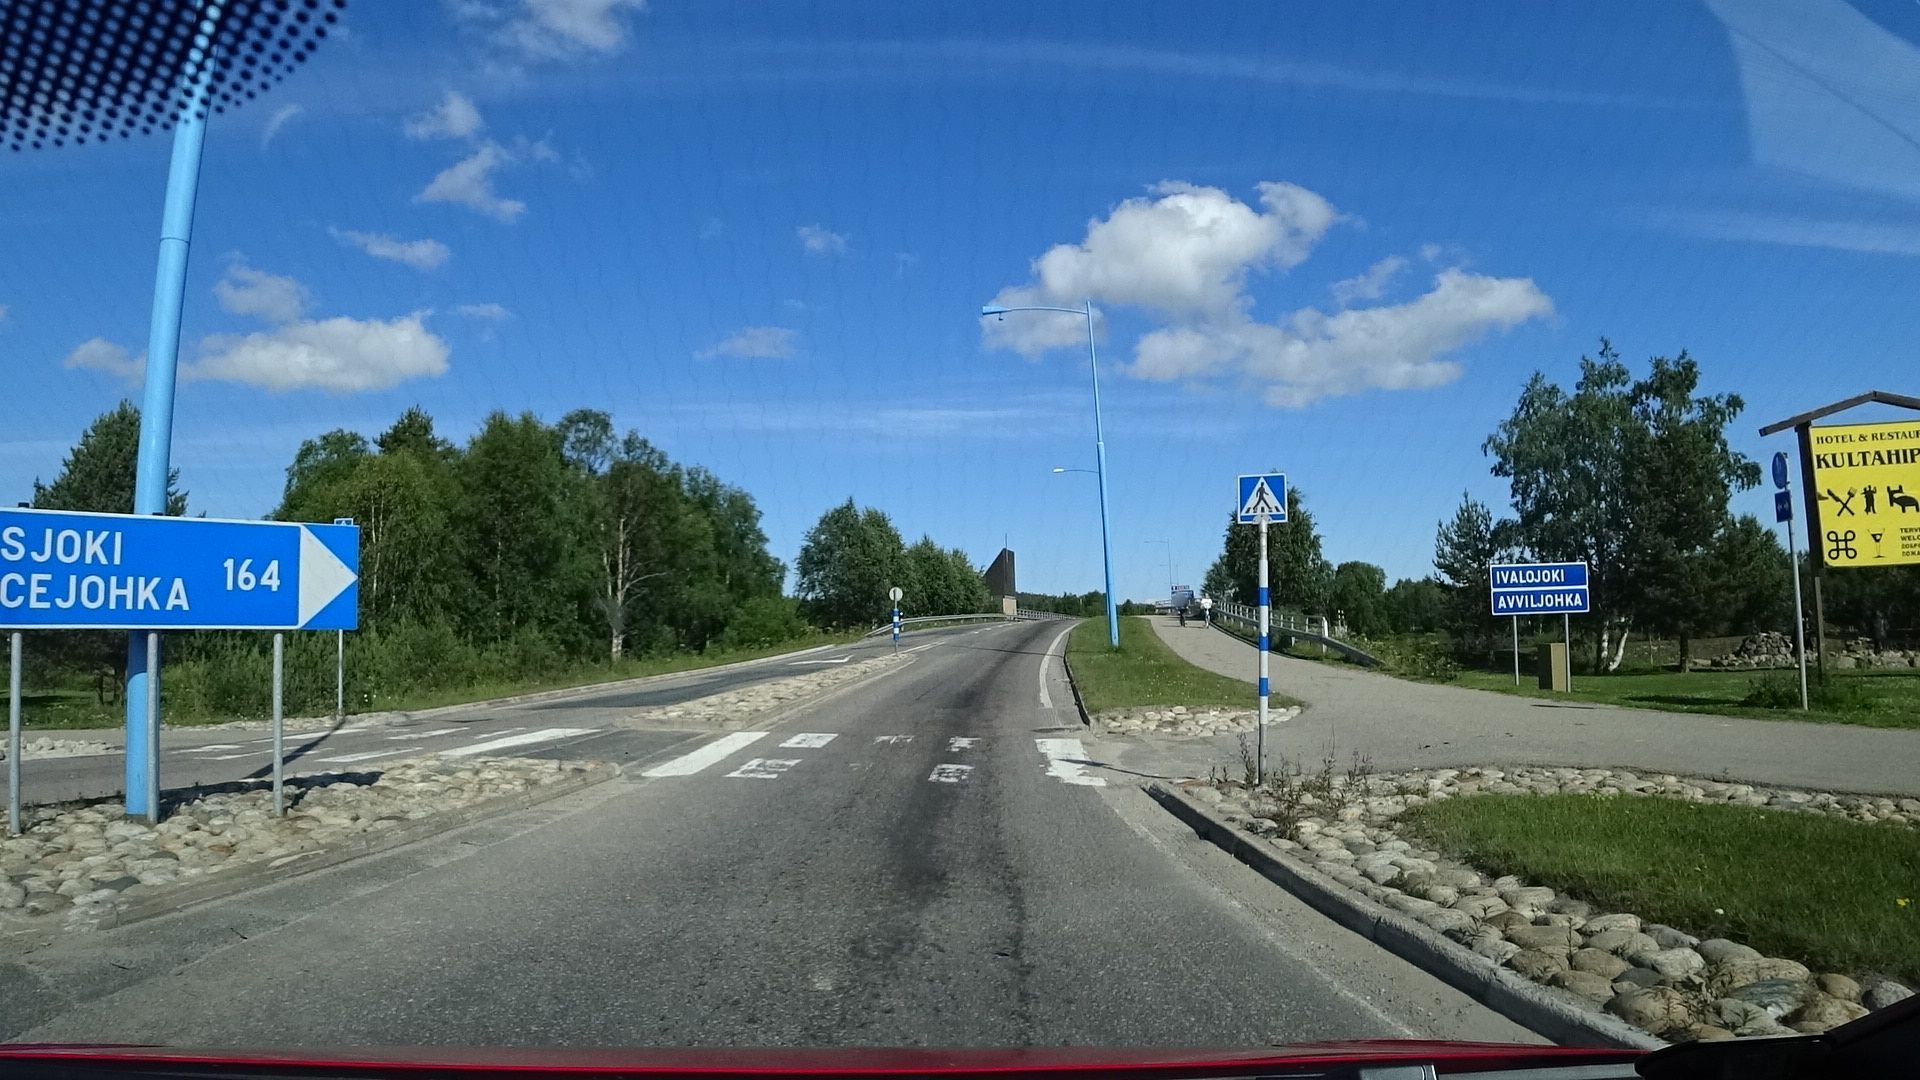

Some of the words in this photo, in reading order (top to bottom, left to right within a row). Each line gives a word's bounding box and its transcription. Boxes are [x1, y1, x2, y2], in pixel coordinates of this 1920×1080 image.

[1816, 434, 1855, 444] HOTEL
[1859, 433, 1868, 442] &
[1815, 448, 1920, 469] KULTAHIP
[0, 526, 122, 565] SJOKI
[223, 558, 280, 592] 164
[1496, 569, 1565, 584] IVALOJOKI
[0, 572, 190, 611] CEJOHKA
[1498, 593, 1583, 609] AVVILJOHKA
